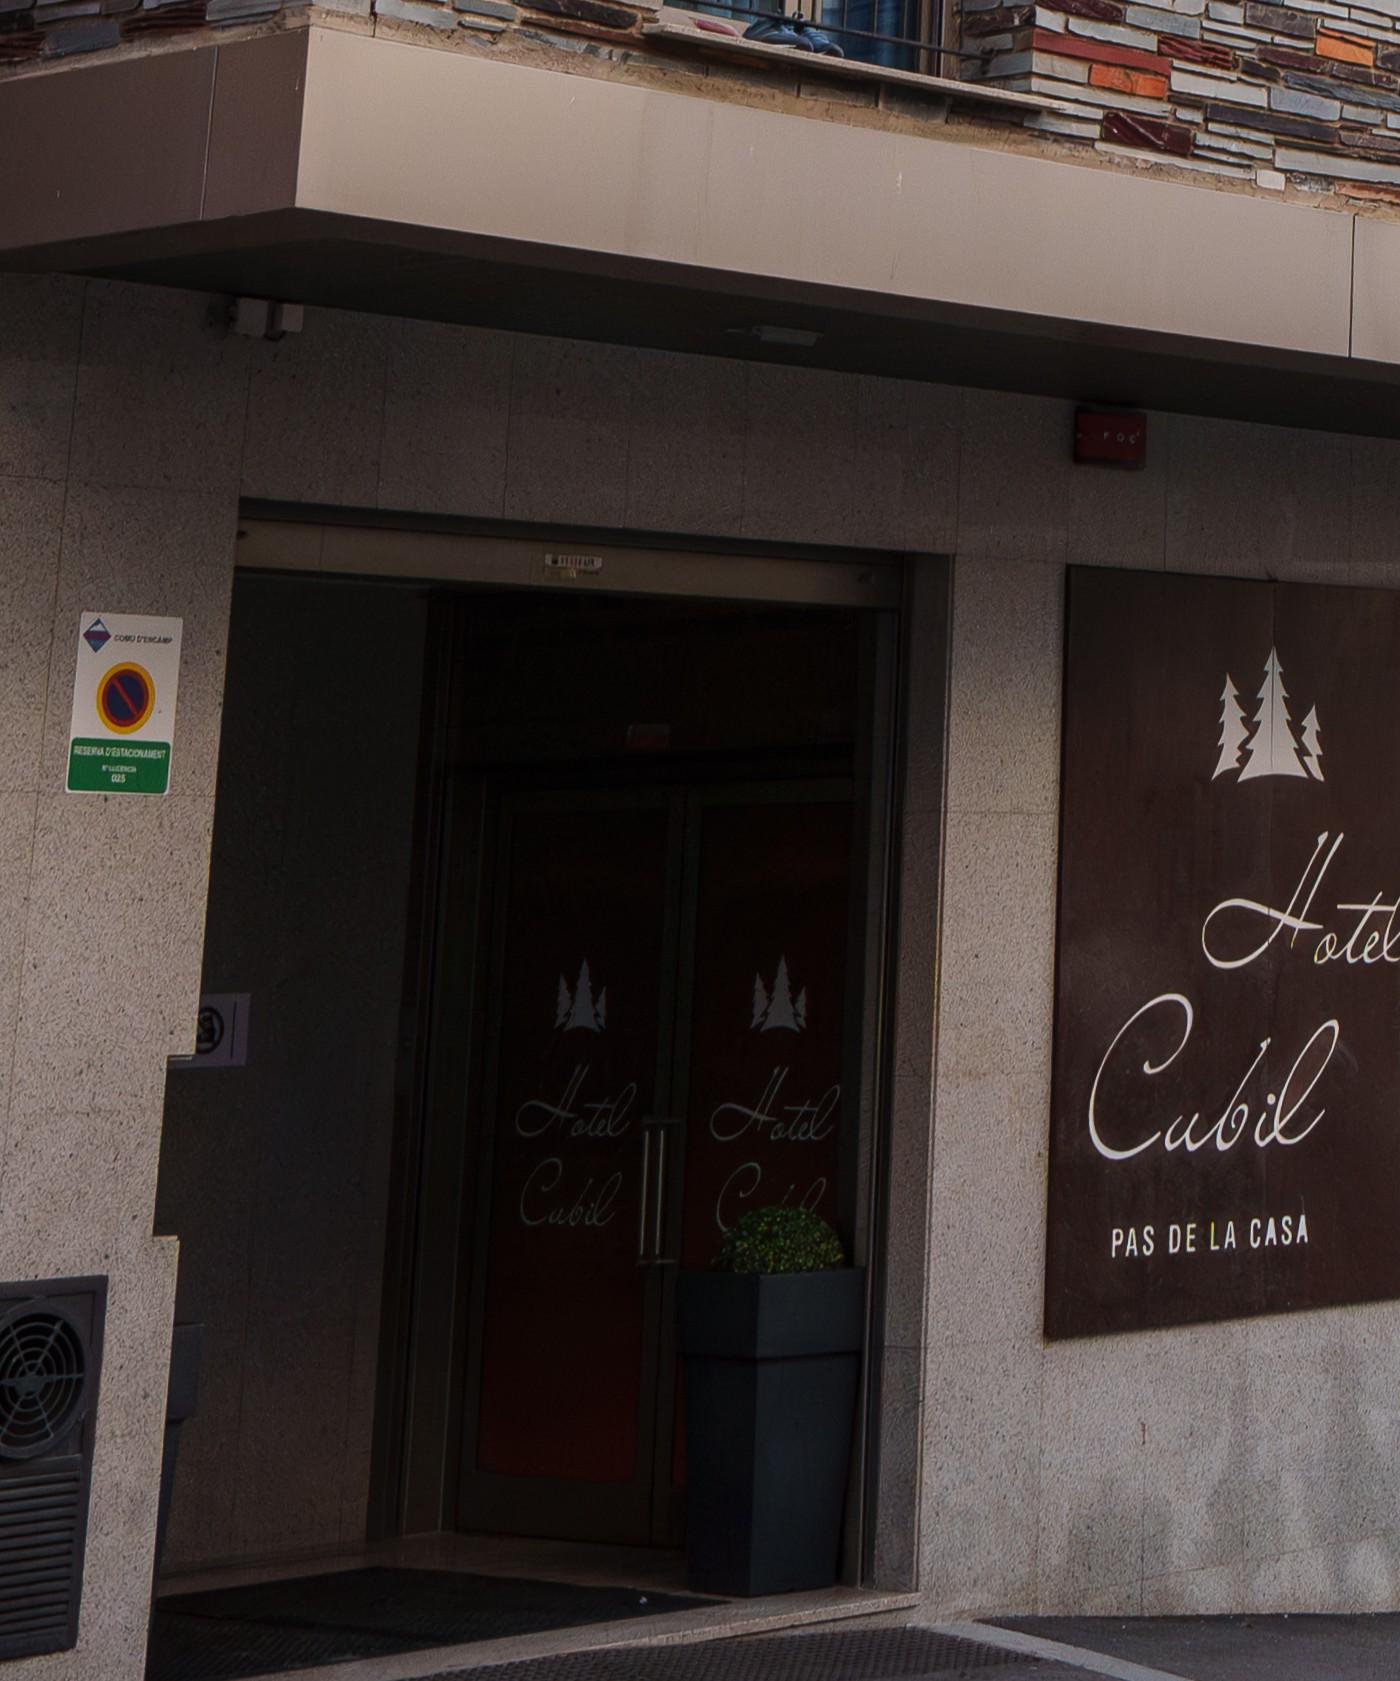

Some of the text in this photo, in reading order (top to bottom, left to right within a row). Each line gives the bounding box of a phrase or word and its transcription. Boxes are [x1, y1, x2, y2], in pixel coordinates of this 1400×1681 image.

[515, 1064, 637, 1137] Hotel
[710, 1065, 841, 1141] Hotel
[1088, 993, 1340, 1160] Cubil
[520, 1158, 623, 1227] Cubil
[1111, 1214, 1309, 1258] PAS DE LA CASA
